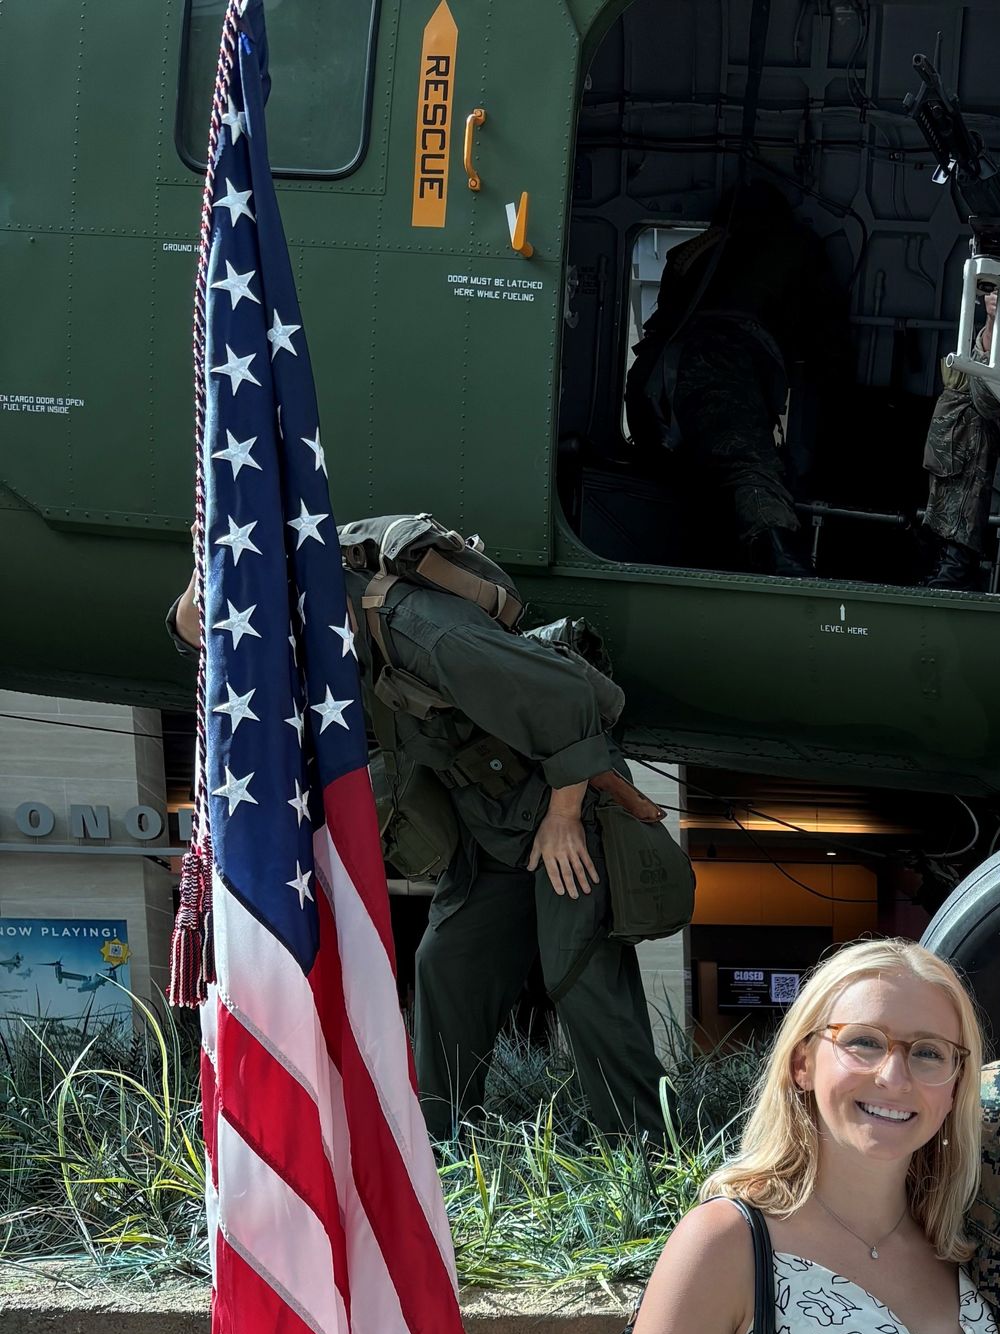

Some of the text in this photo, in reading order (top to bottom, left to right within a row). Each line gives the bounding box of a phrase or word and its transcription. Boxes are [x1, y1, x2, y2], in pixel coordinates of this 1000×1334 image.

[418, 55, 451, 200] RESCUE
[163, 243, 192, 252] GROUND
[447, 274, 543, 290] DOOR MUST BE LATCHED
[453, 288, 535, 302] HERE WHILE FUELING
[10, 395, 34, 404] CARGO
[35, 396, 55, 405] DOOR
[56, 397, 64, 406] IS
[65, 398, 85, 407] OPEN
[3, 403, 70, 414] FUEL FILLER INSIDE
[820, 624, 868, 636] LEVEL HERE
[41, 927, 118, 938] PLAYING!
[734, 970, 764, 981] CLOSED
